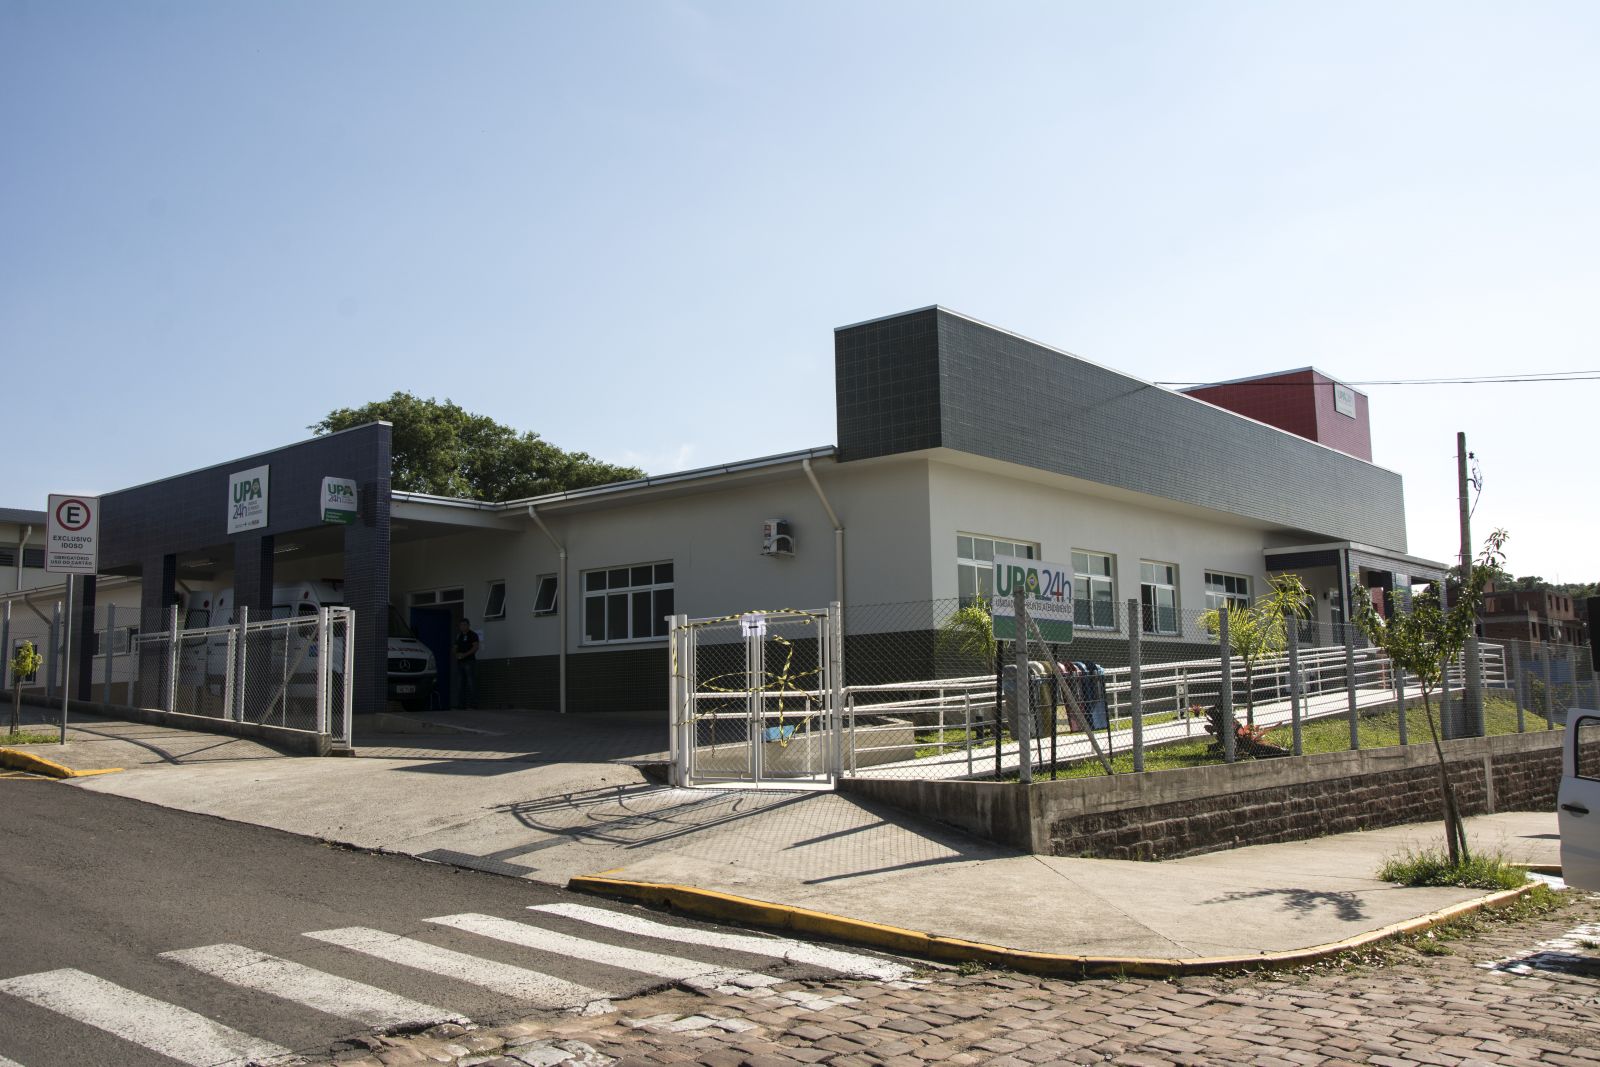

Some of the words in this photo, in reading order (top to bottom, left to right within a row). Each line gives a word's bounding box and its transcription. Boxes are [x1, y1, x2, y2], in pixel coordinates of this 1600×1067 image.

[233, 478, 262, 504] UPA
[327, 483, 354, 497] UPA
[67, 506, 80, 523] E
[233, 503, 248, 520] 24h
[996, 563, 1041, 601] UPA
[1041, 569, 1072, 604] 24h
